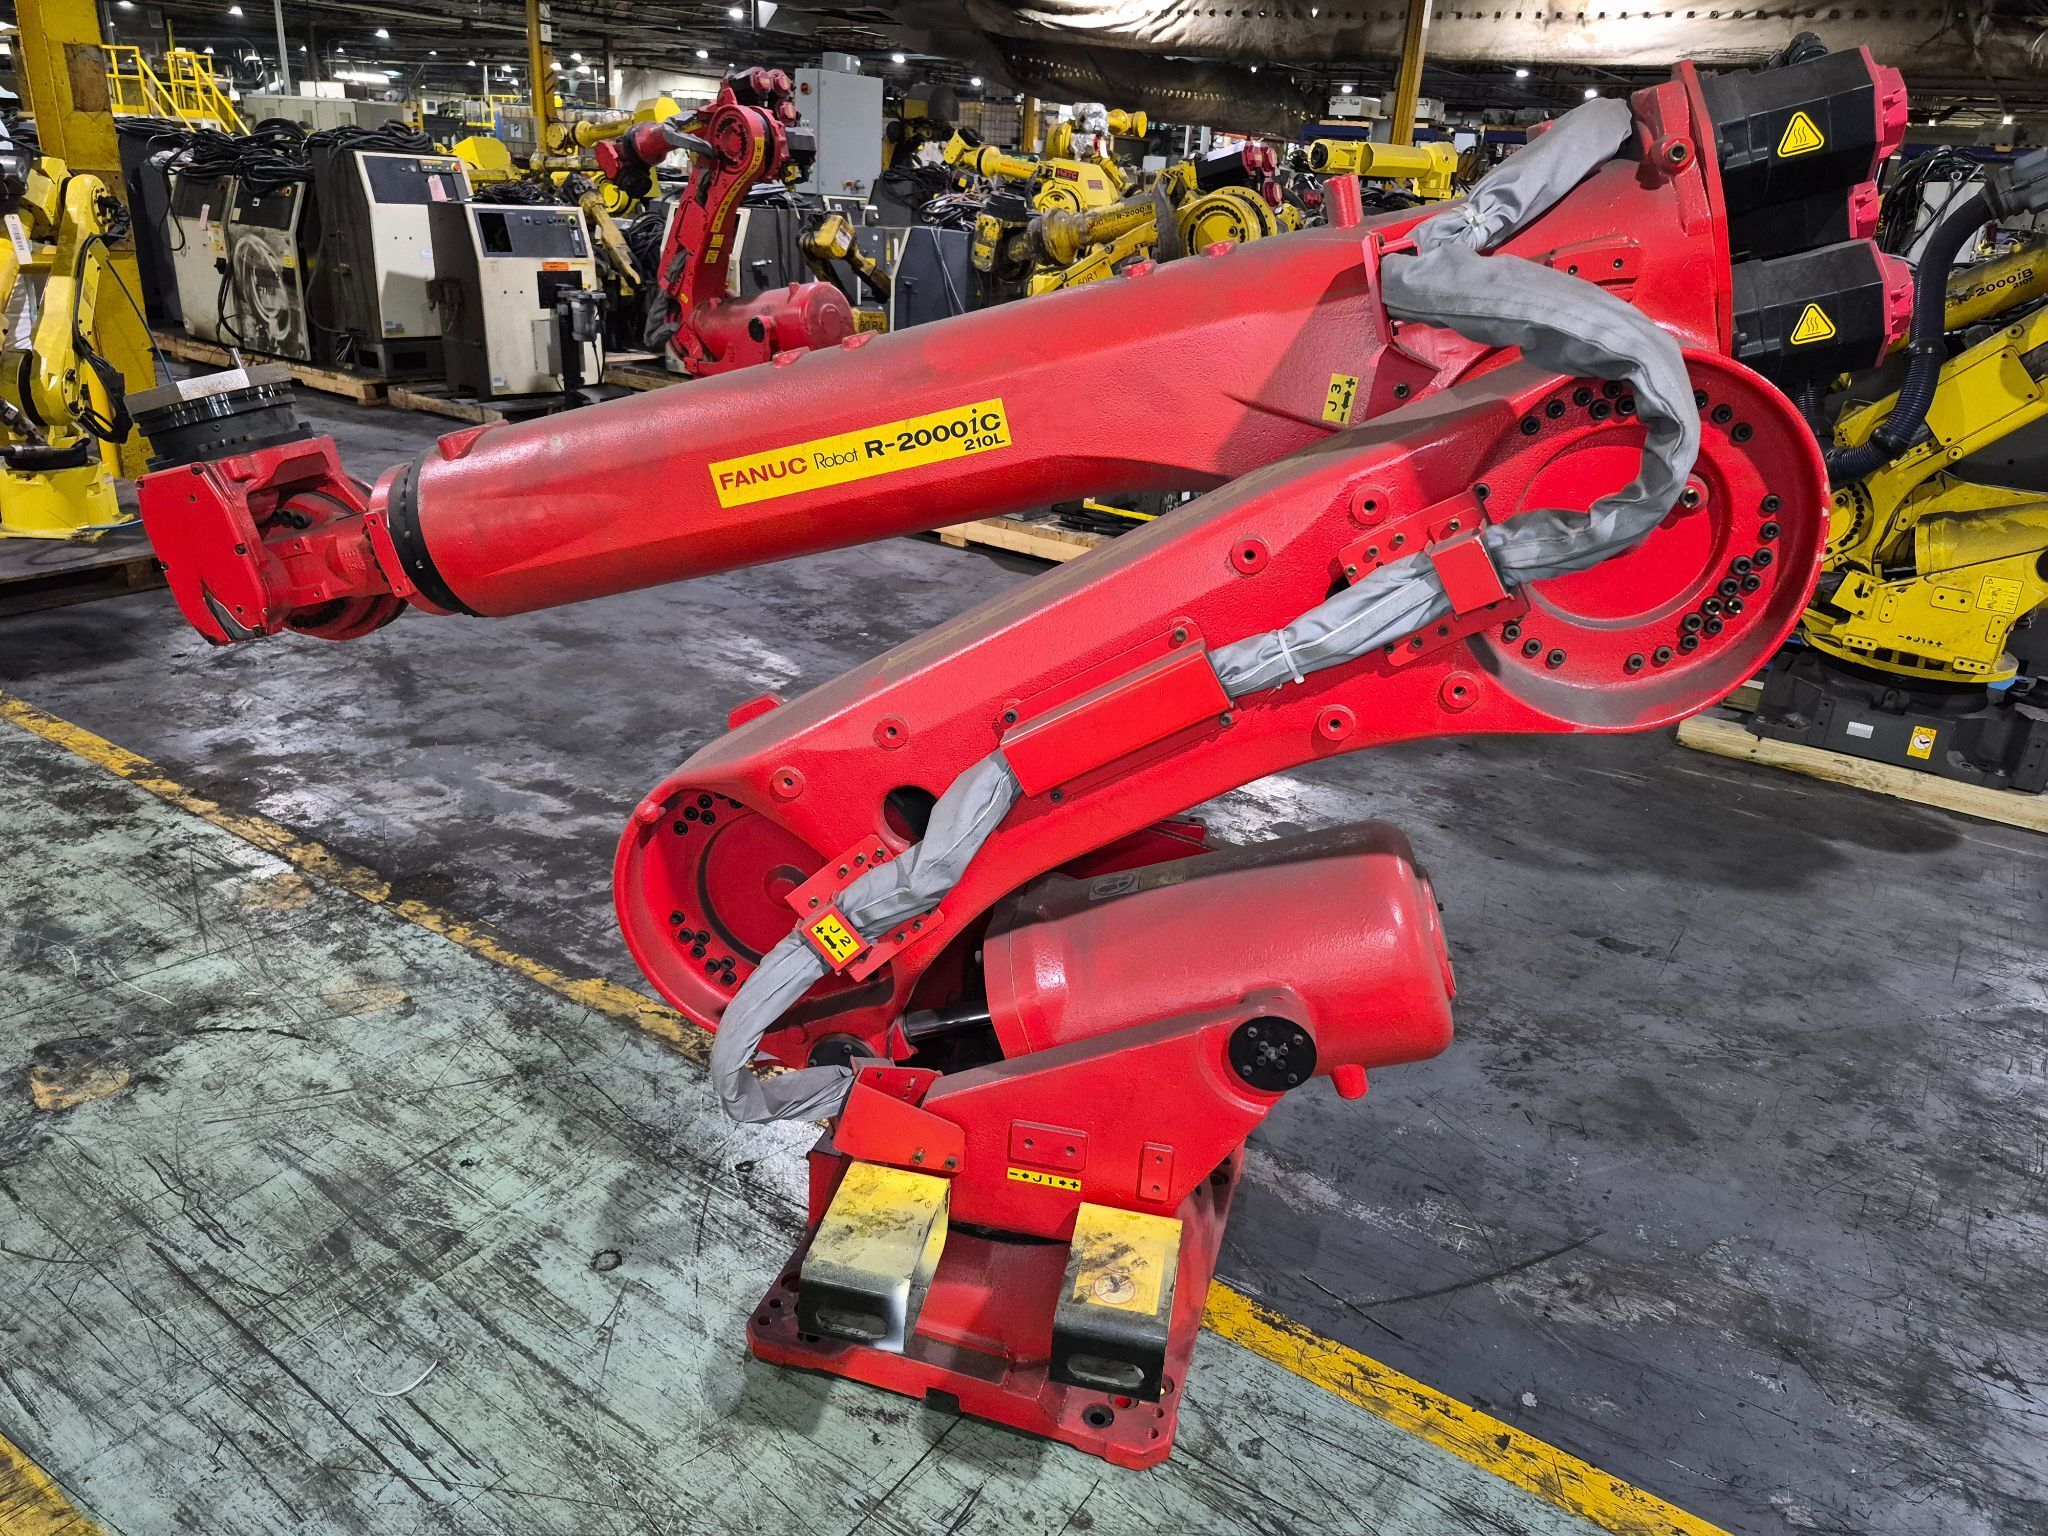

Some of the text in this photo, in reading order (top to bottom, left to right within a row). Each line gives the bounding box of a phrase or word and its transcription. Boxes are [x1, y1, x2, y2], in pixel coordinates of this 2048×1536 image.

[718, 407, 1002, 491] FANUC Robot R-2000iC
[963, 432, 1006, 452] 210L
